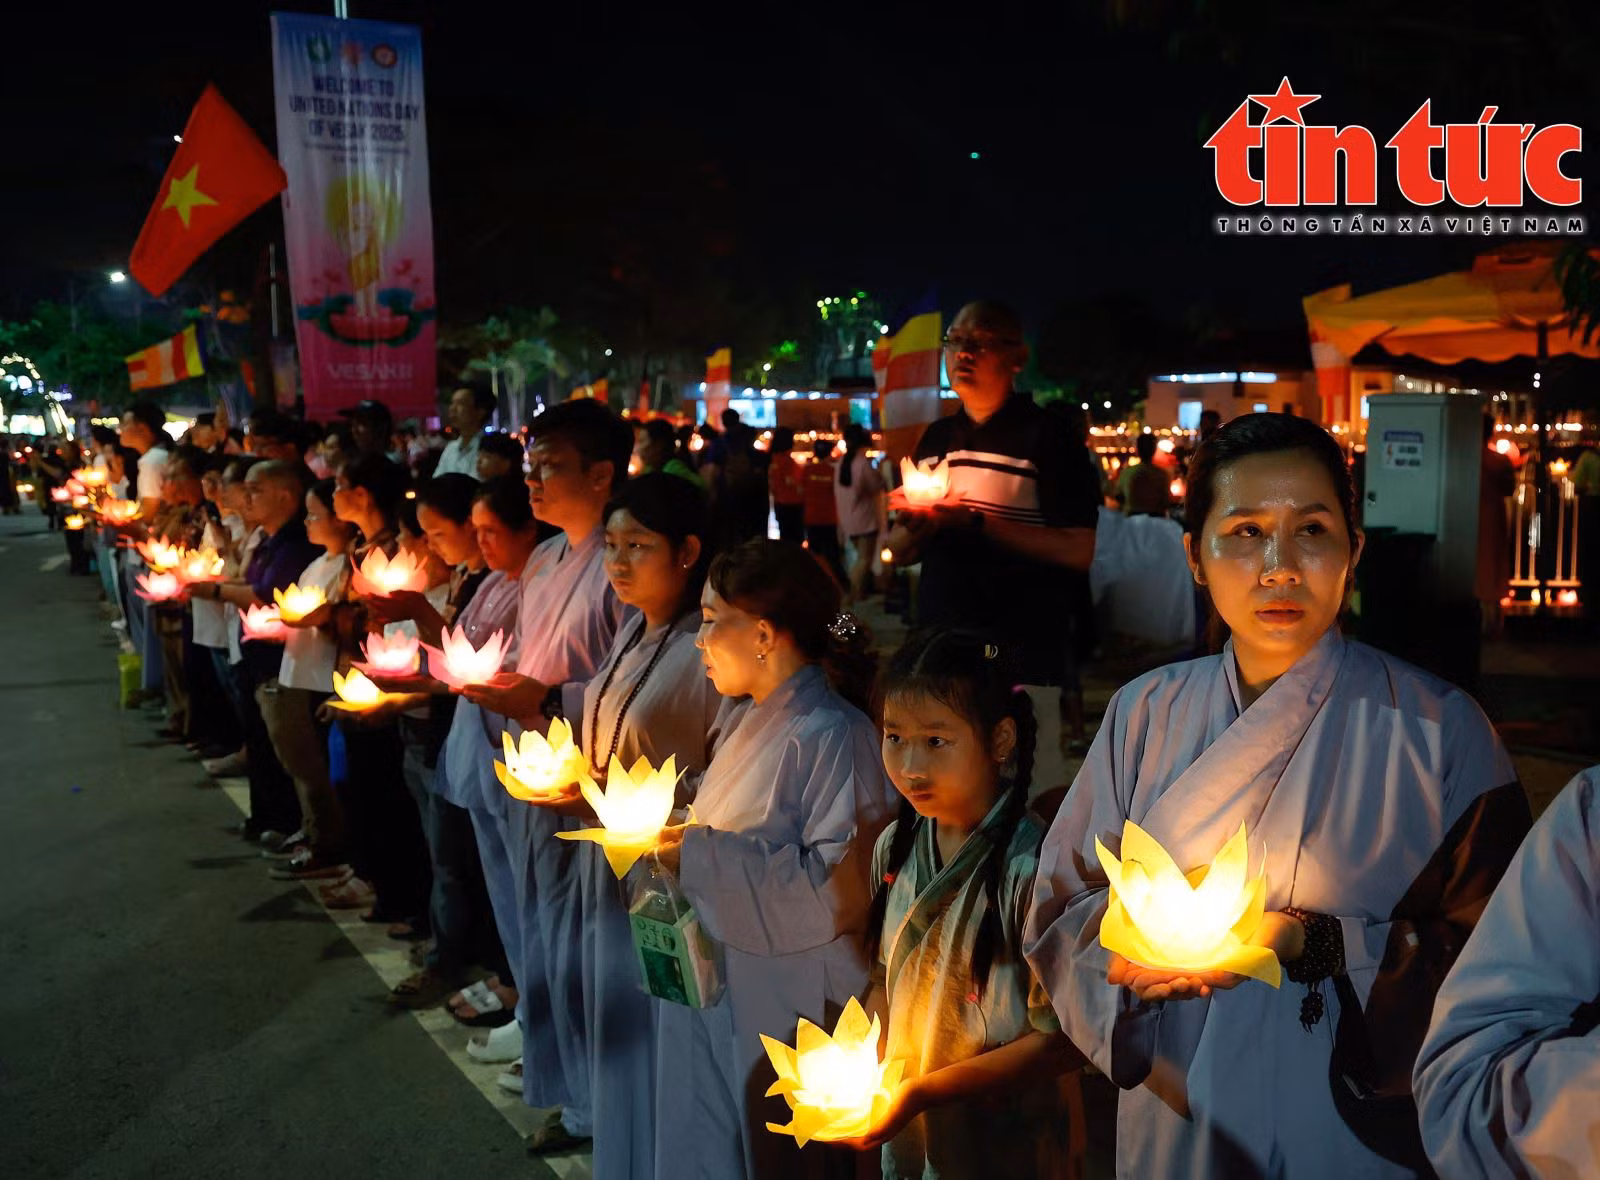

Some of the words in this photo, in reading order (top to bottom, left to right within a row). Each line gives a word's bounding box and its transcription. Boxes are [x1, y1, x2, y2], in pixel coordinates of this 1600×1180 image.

[313, 75, 377, 95] WELCOME
[379, 80, 395, 96] TO
[289, 96, 336, 115] UNITED
[338, 99, 391, 118] NATIONS
[395, 102, 420, 120] DAY
[308, 119, 324, 136] OF
